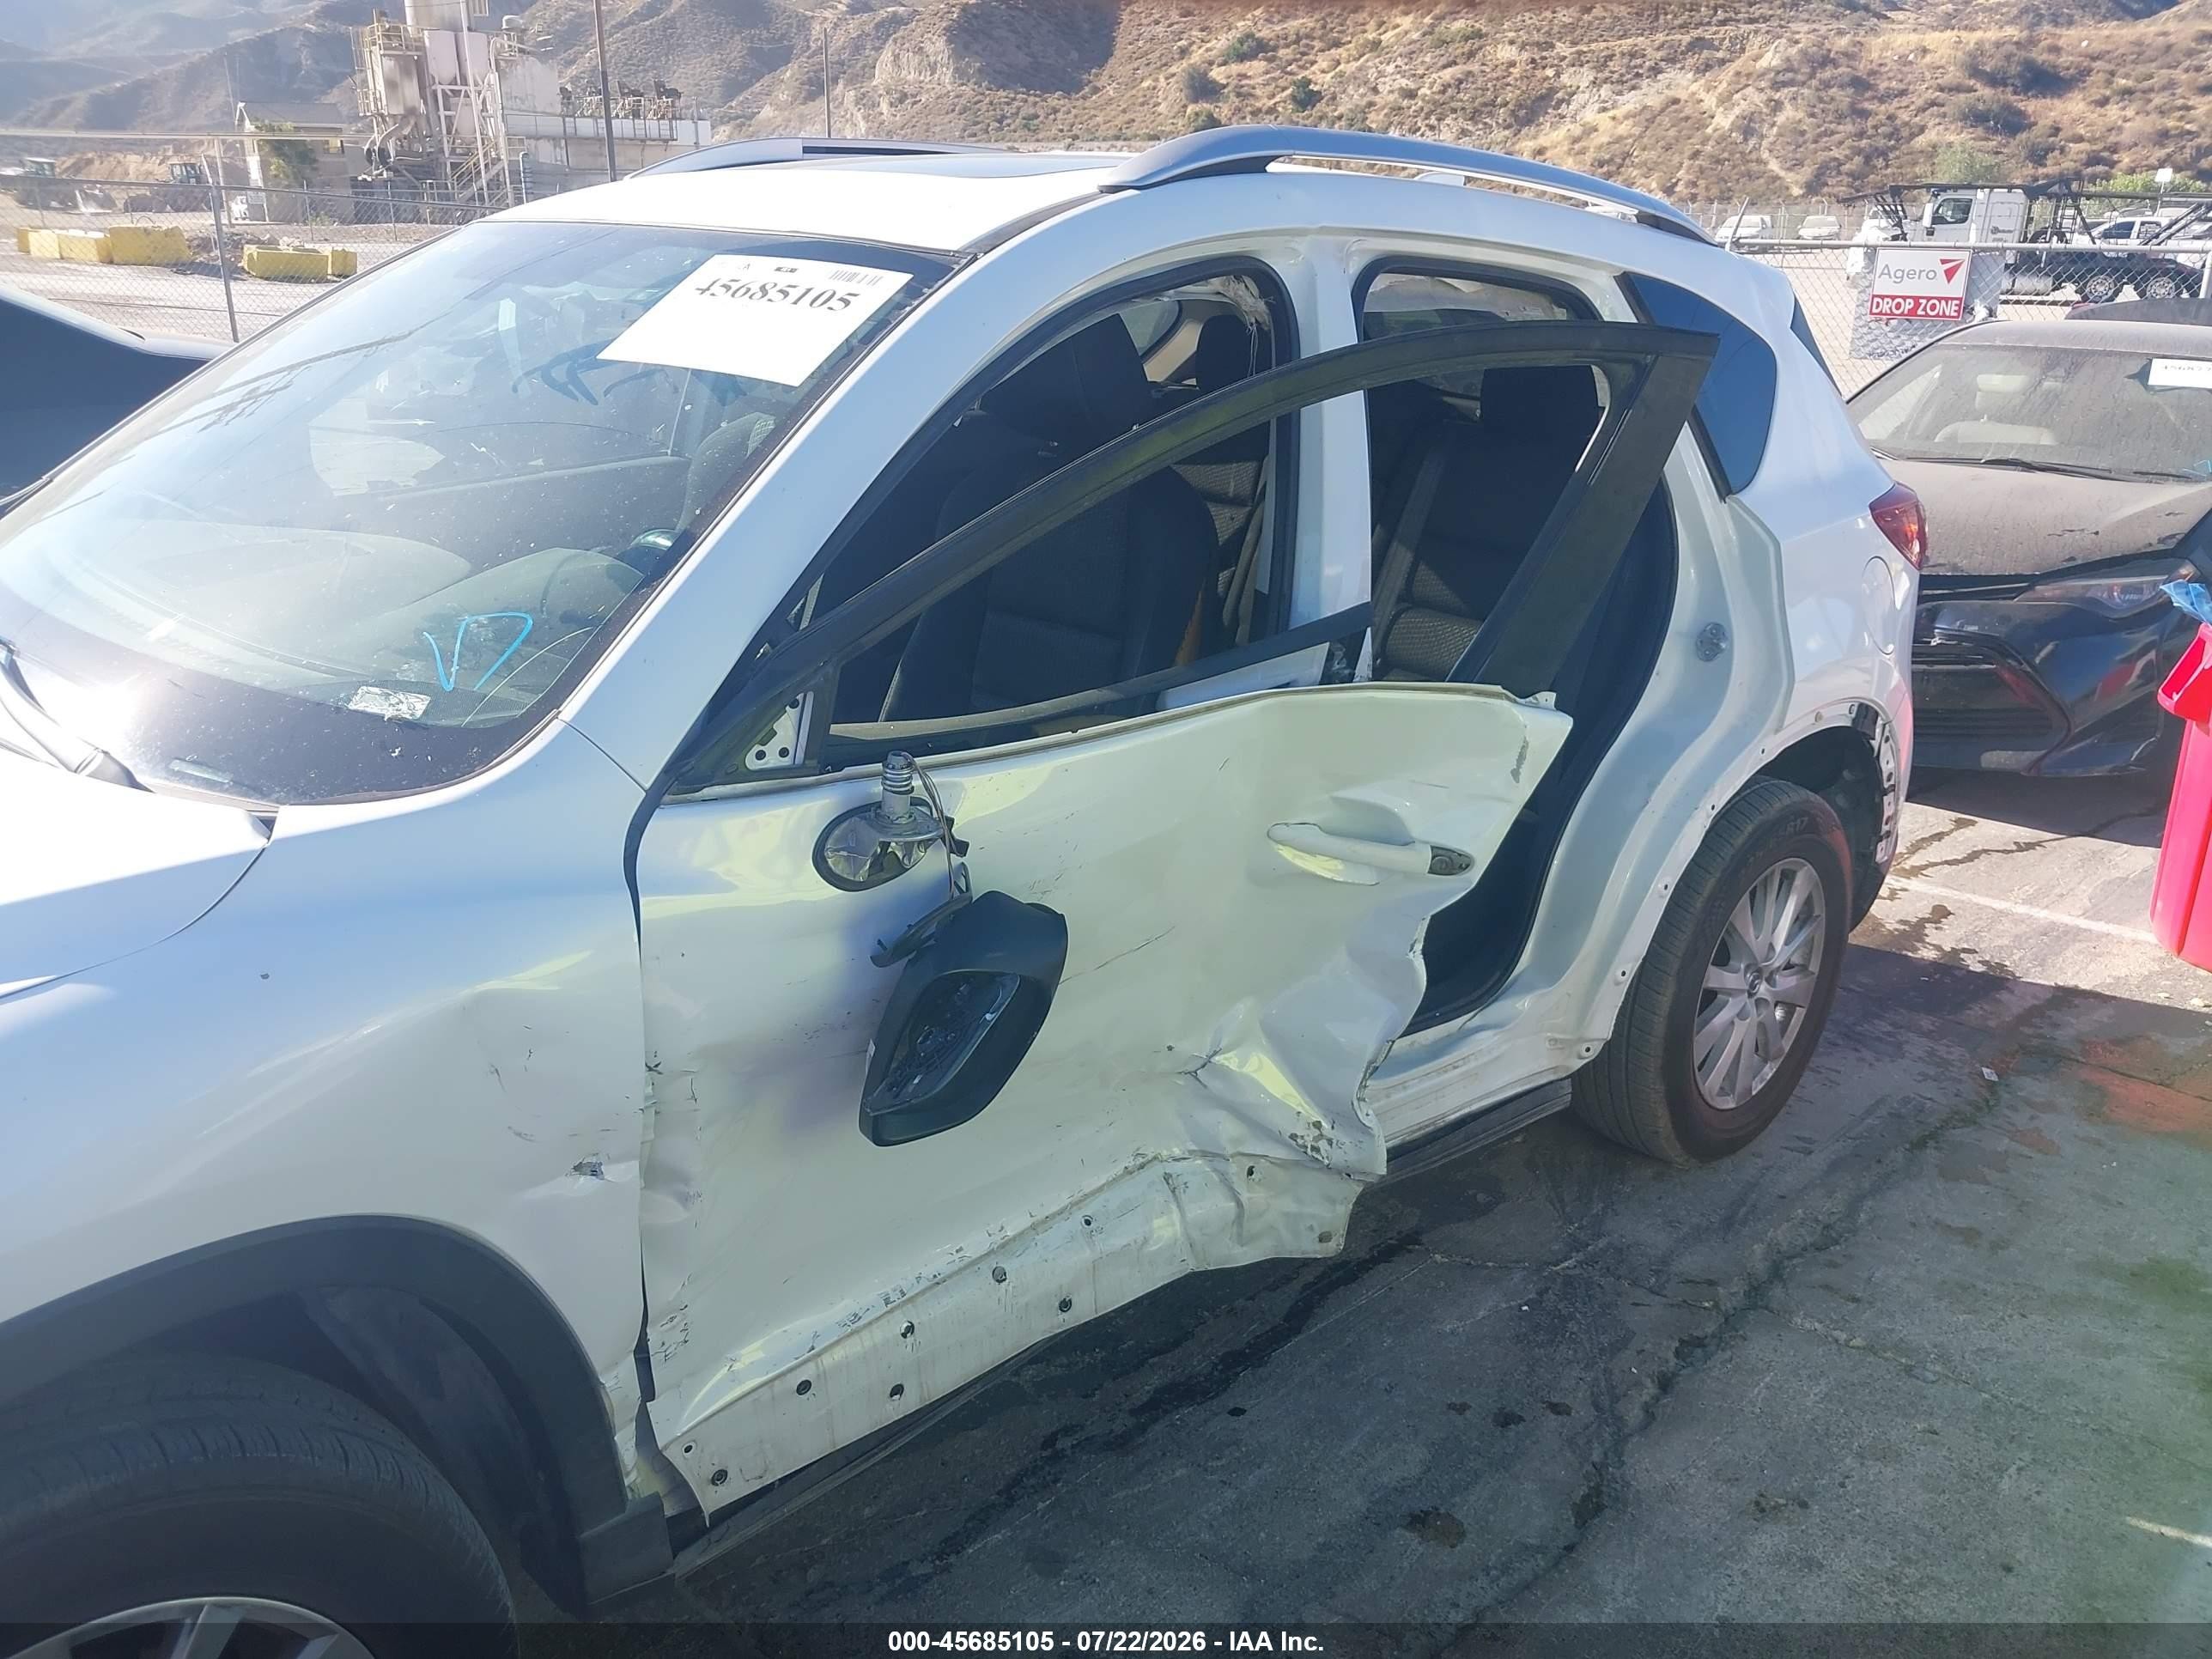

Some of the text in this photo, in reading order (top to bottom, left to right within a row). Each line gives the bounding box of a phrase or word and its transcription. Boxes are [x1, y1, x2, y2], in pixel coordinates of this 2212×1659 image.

[1878, 264, 1937, 284] Agero
[696, 278, 860, 310] 45685105
[1872, 297, 1960, 317] DROP ZONE
